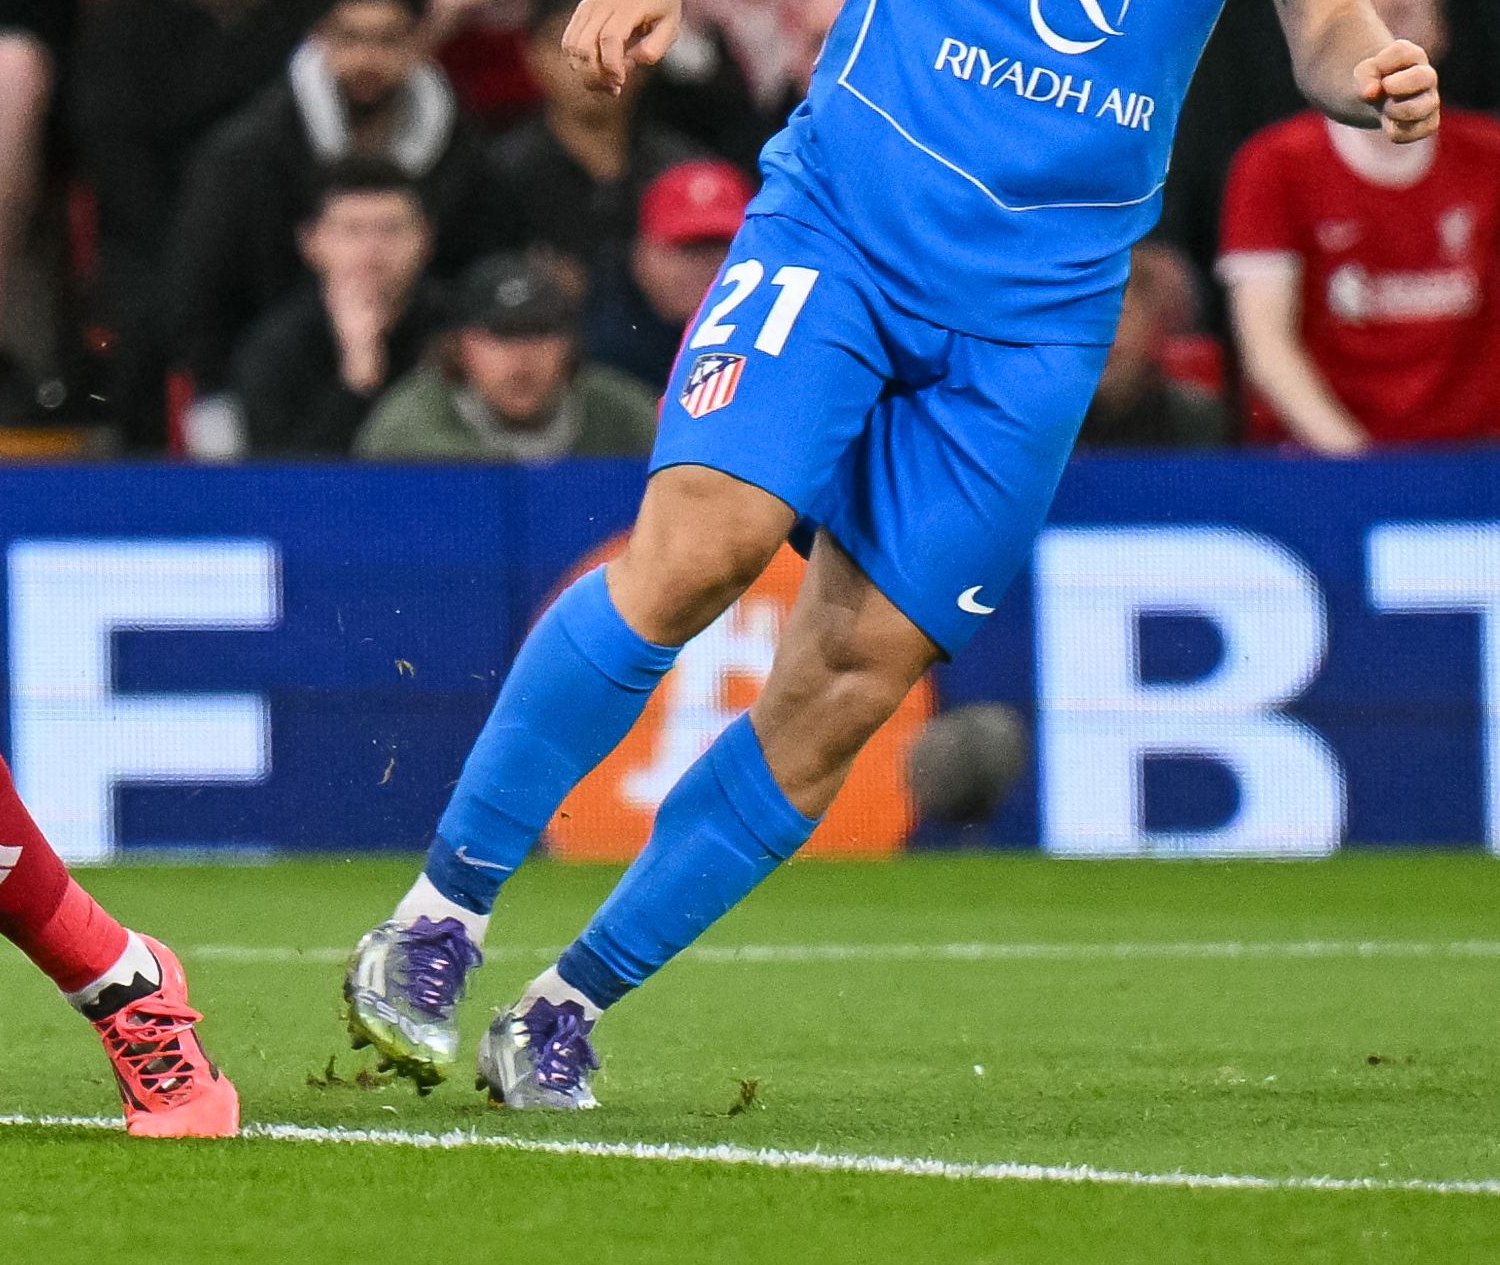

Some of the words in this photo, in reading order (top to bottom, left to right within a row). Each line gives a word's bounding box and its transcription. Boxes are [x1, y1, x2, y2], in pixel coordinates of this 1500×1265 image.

[934, 37, 1093, 113] RIYADH
[1096, 87, 1155, 132] AIR
[689, 259, 820, 357] 21
